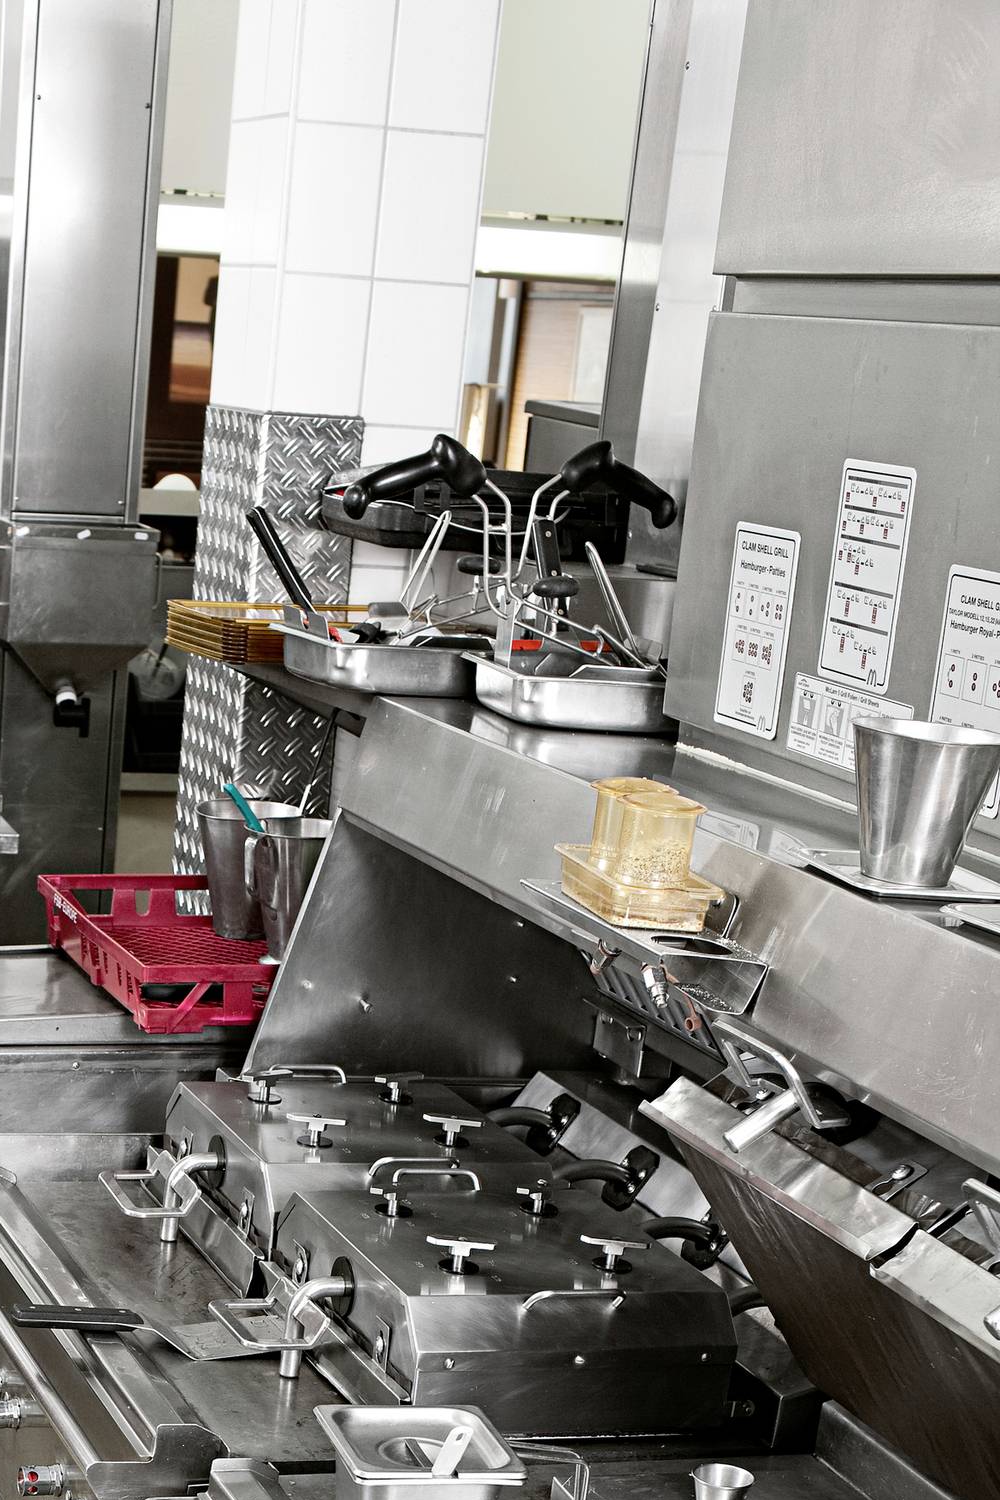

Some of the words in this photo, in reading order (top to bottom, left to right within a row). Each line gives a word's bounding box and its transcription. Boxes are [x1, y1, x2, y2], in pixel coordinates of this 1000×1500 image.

[741, 540, 756, 551] CLAM
[757, 543, 773, 556] SHELL
[774, 547, 788, 558] GRILL
[960, 594, 976, 606] CLAM
[977, 598, 994, 610] SHELL
[950, 619, 978, 634] Hamburger
